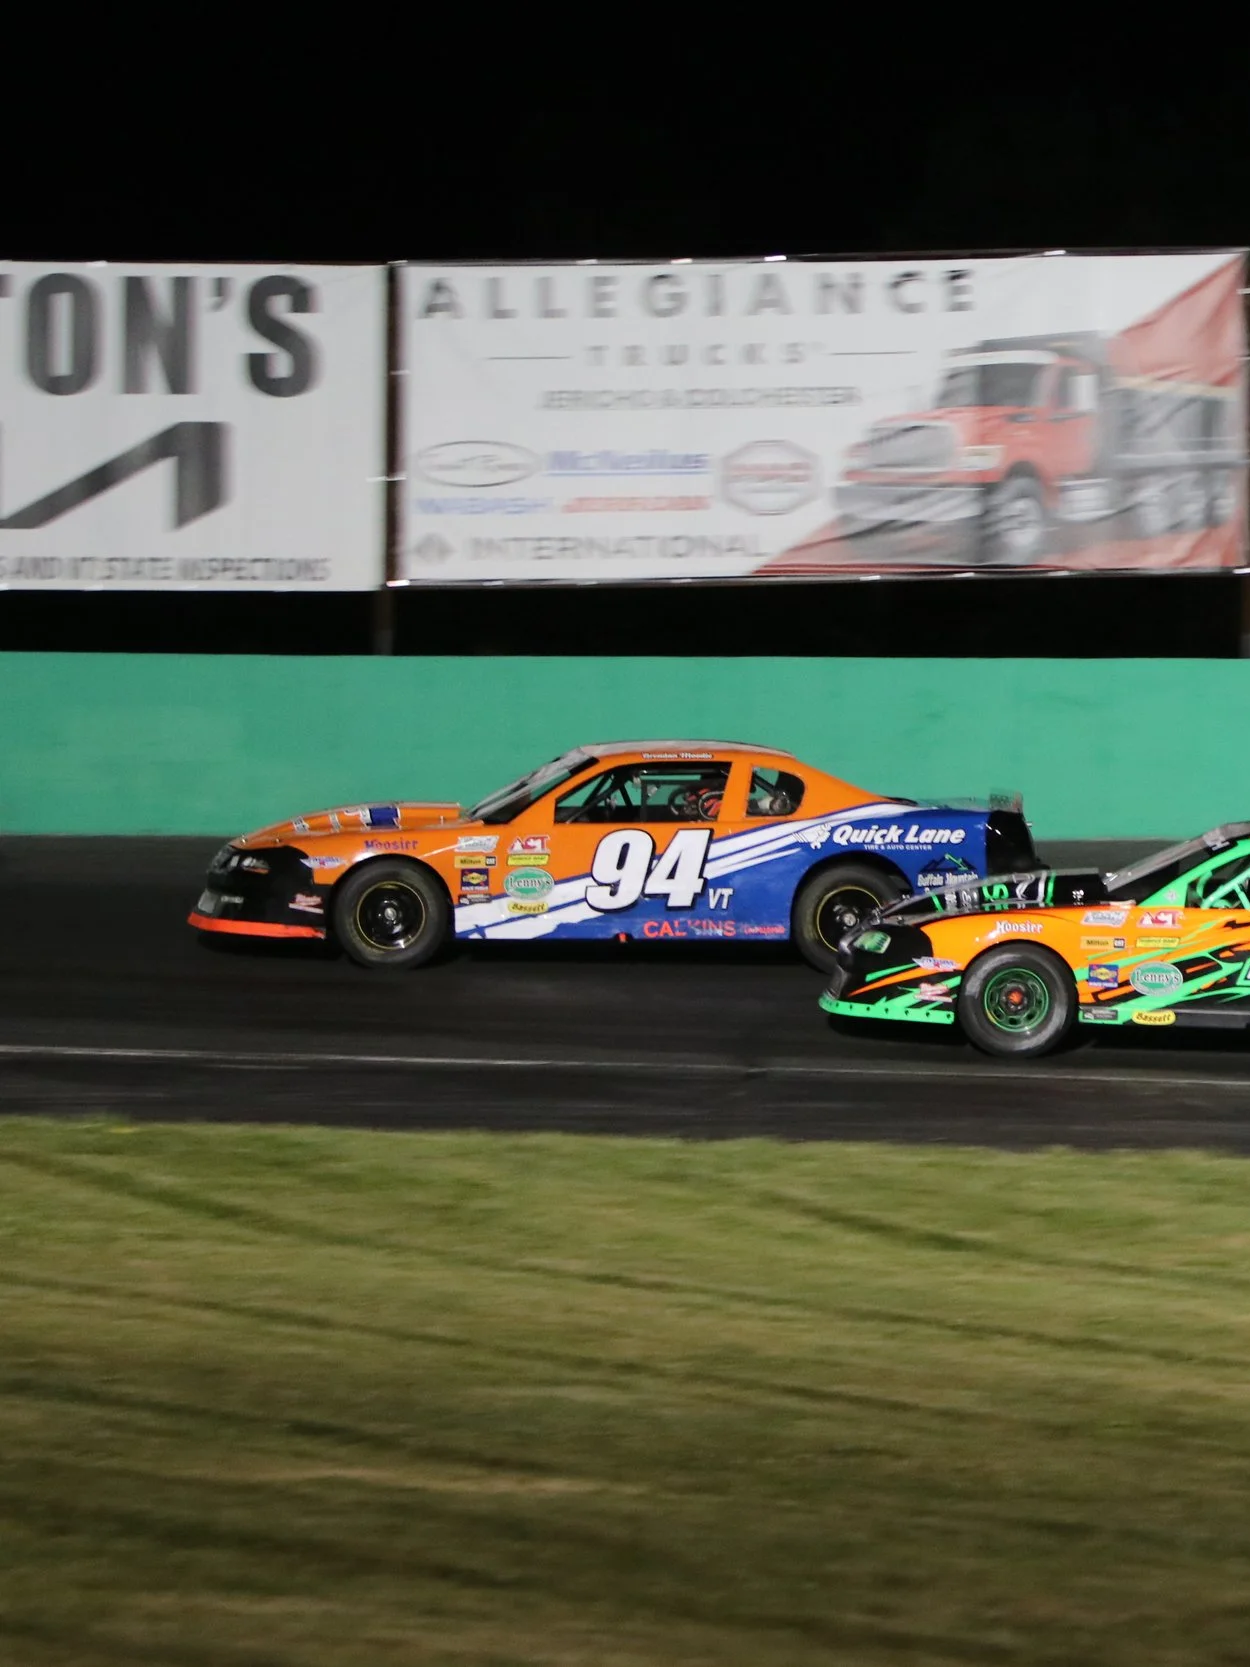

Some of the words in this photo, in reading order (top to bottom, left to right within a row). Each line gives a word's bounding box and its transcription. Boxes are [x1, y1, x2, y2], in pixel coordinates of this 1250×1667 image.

[415, 269, 975, 320] ALLEGIANCE
[0, 272, 321, 398] ON'S
[582, 341, 808, 366] TRUCKS
[470, 535, 770, 561] INTERNATIONAL
[179, 557, 331, 581] INSPECTIONS
[364, 838, 419, 850] Hoosier
[510, 836, 549, 852] ACT
[832, 825, 903, 845] Quick
[905, 825, 966, 844] Lane
[587, 829, 713, 912] 94
[510, 877, 551, 893] Lenny's
[708, 887, 734, 909] VT
[996, 920, 1043, 933] Hoosier
[1139, 910, 1180, 926] ACT
[1136, 970, 1180, 984] Lenny's
[1136, 1012, 1172, 1021] Bassett
